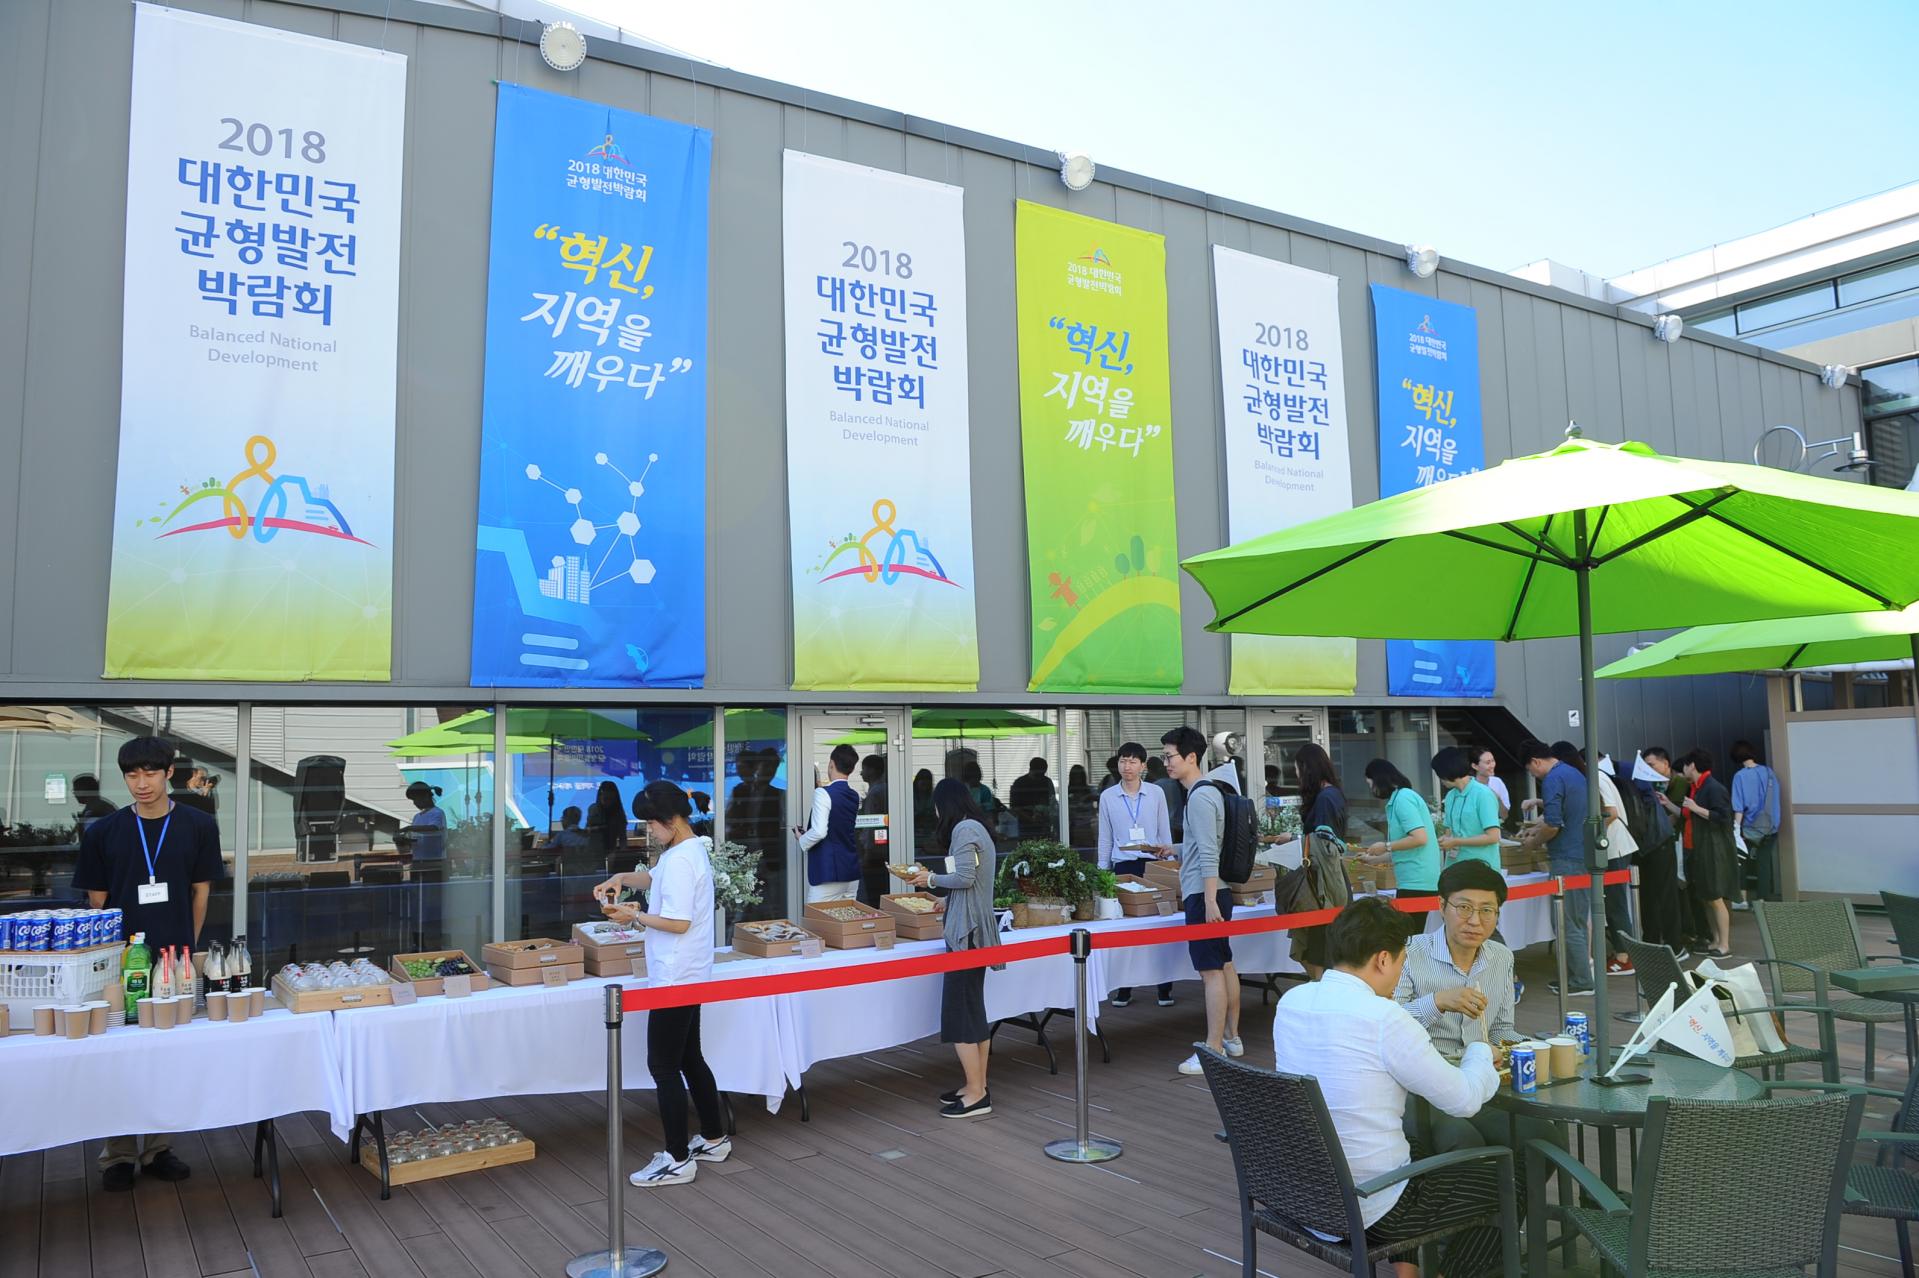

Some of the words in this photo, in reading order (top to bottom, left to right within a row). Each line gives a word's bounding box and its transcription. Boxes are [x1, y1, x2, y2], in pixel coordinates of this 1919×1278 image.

[219, 117, 327, 164] 2018
[177, 157, 361, 224] 대한민국
[566, 173, 647, 203] 균형발전박람회
[567, 159, 600, 175] 2018
[602, 165, 648, 187] 대한민국
[174, 210, 358, 276] 균형발전
[534, 223, 655, 300] “혁신,
[841, 240, 913, 280] 2018
[1067, 261, 1088, 275] 2018
[198, 270, 333, 325] 박람회
[816, 274, 938, 328] 대한민국
[189, 324, 265, 344] Balanced
[269, 331, 338, 353] National
[520, 290, 653, 353] 지역을
[1254, 321, 1310, 351] 2018
[207, 348, 319, 372] Development
[816, 318, 939, 370] 균형발전
[1049, 315, 1134, 376] “혁신,
[543, 350, 693, 401] 깨우다”
[833, 365, 925, 409] 박람회
[1242, 347, 1328, 391] 대한민국
[1043, 371, 1135, 419] 지역을
[1243, 383, 1330, 426] 균형발전
[1402, 377, 1457, 429] “혁신,
[829, 410, 883, 427] Balanced
[885, 415, 930, 432] National
[842, 428, 919, 447] Development
[1063, 418, 1161, 458] 깨우다”
[1257, 422, 1320, 460] 박람회
[1400, 424, 1459, 466] 지역을
[1287, 466, 1324, 480] National
[31, 922, 51, 936] Cass
[54, 921, 74, 936] Cass
[1566, 1022, 1588, 1036] Cass
